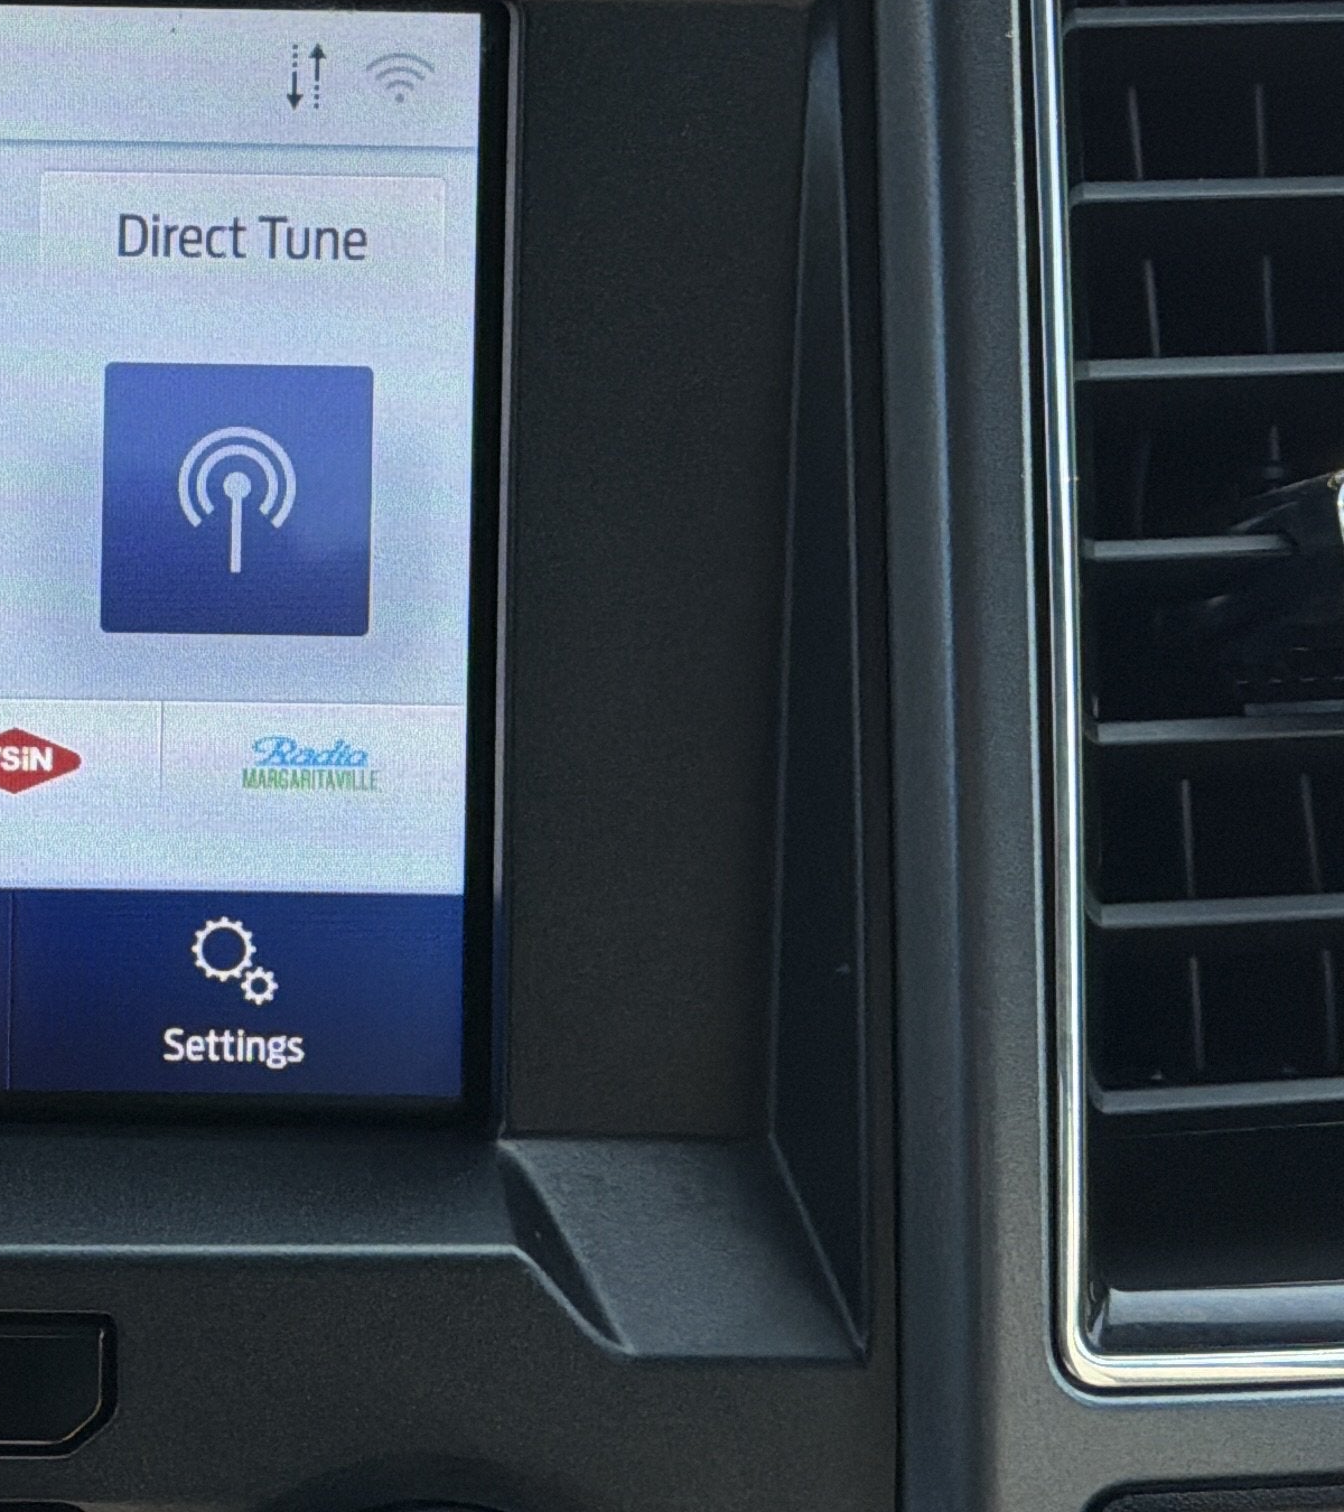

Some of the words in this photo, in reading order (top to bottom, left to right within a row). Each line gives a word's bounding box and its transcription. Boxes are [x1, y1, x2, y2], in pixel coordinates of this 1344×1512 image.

[117, 213, 247, 261] Direct
[259, 216, 370, 262] Tune
[252, 735, 369, 767] Radio
[242, 767, 381, 792] MARGARITAVILLE
[163, 1028, 305, 1069] Settings
